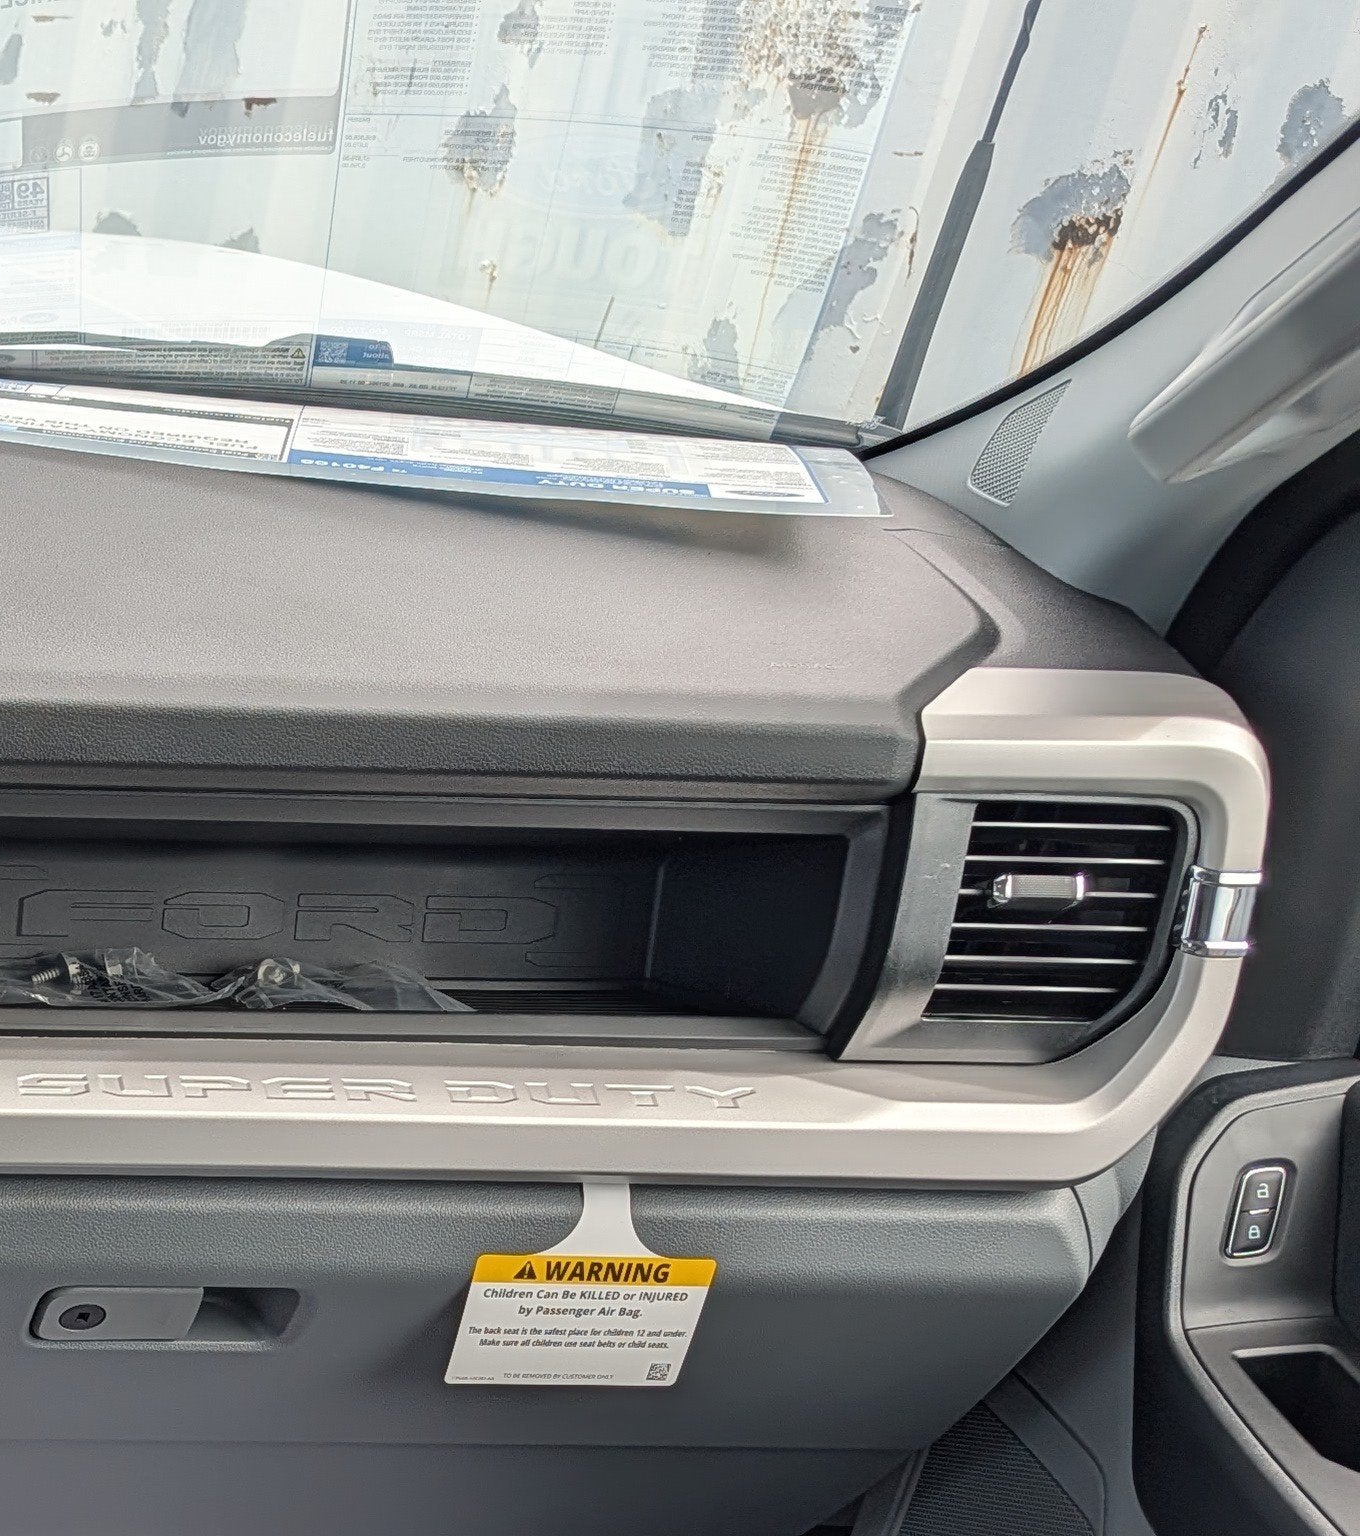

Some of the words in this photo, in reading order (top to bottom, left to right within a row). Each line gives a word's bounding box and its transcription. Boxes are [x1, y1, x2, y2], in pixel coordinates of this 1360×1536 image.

[16, 1072, 417, 1103] SUPER
[443, 1079, 757, 1110] DUTY
[545, 1260, 671, 1284] WARNING
[483, 1288, 534, 1300] Children
[536, 1290, 559, 1300] Can
[562, 1290, 577, 1300] Be
[579, 1290, 620, 1300] KILLED
[622, 1292, 636, 1300] or
[638, 1292, 688, 1302] INJURED
[518, 1306, 532, 1316] by
[536, 1306, 594, 1318] Passenger
[597, 1307, 614, 1316] Air
[618, 1308, 642, 1319] Bag.
[468, 1326, 482, 1334] The
[544, 1328, 566, 1336] safest
[568, 1328, 588, 1337] place
[590, 1328, 601, 1336] for
[603, 1328, 634, 1337] children
[647, 1329, 661, 1337] and
[520, 1339, 530, 1347] all
[532, 1340, 562, 1348] children
[597, 1340, 616, 1348] belts
[628, 1340, 646, 1348] child
